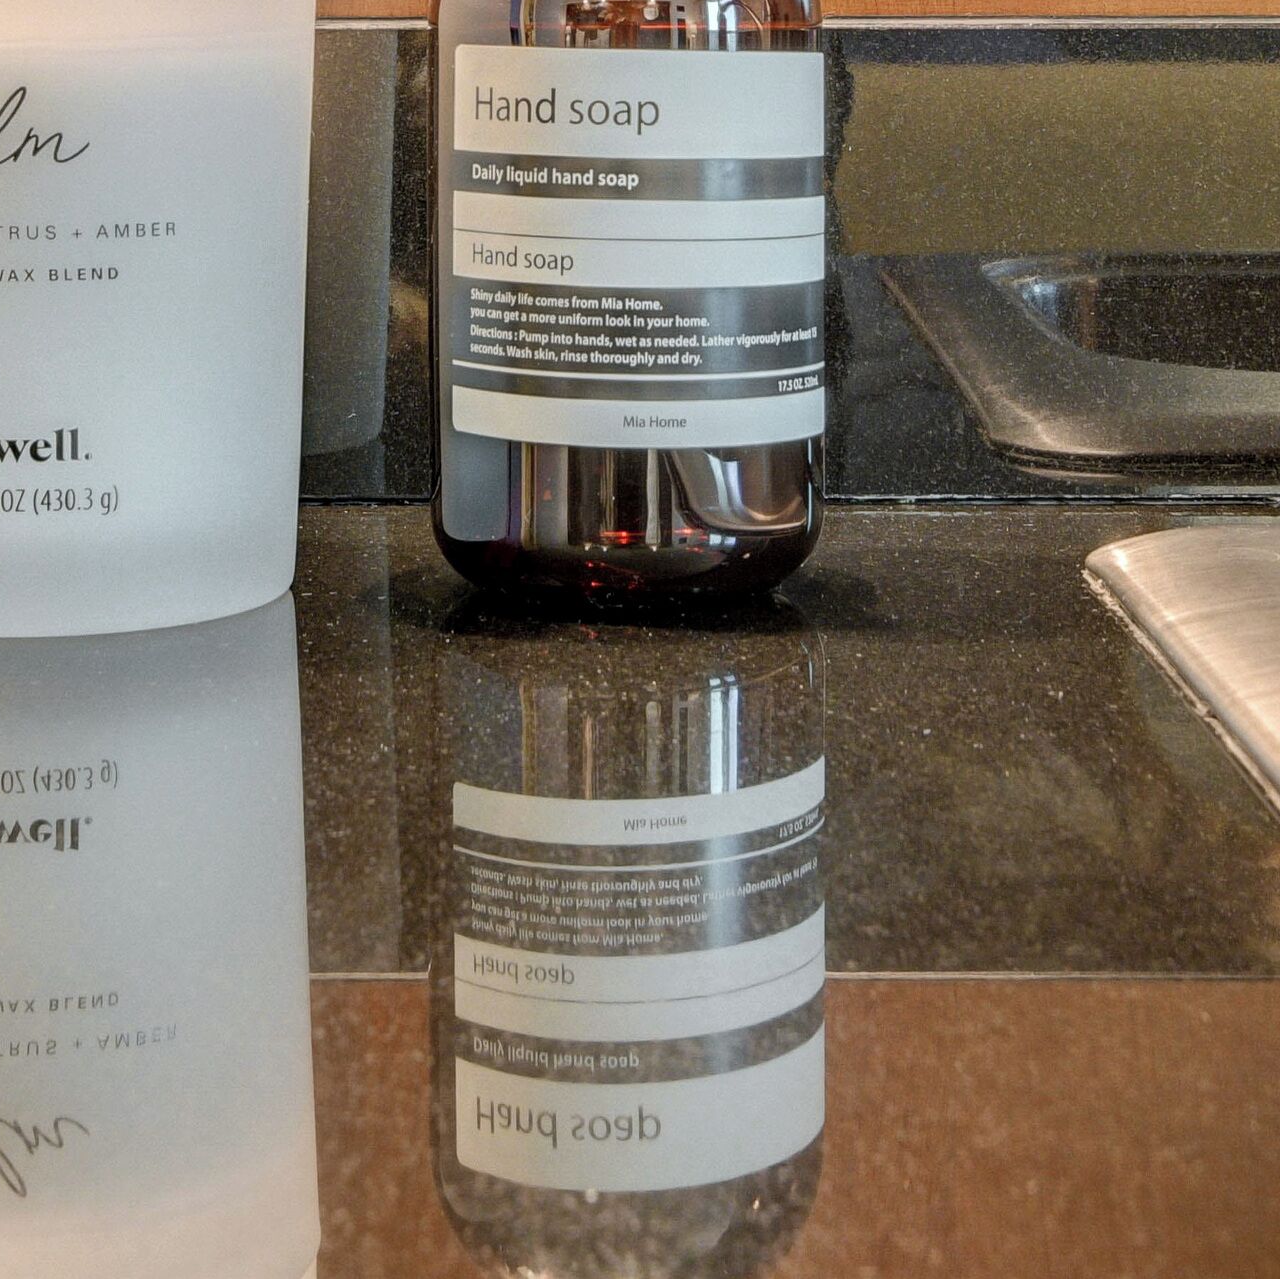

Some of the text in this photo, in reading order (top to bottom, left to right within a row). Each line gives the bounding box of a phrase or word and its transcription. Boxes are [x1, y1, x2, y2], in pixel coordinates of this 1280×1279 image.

[475, 86, 660, 135] Hand soap
[472, 163, 639, 190] Daily liquid hand soap
[96, 222, 177, 239] AMBER
[472, 243, 574, 276] Hand soap
[48, 267, 119, 281] BLEND
[470, 288, 663, 311] Shiny daily life comes from Mia Home.
[470, 308, 710, 330] you can get a more uniform look in your home.
[470, 324, 513, 340] Directions
[519, 329, 549, 346] Pump
[550, 332, 573, 345] into
[575, 333, 613, 348] hands,
[615, 336, 637, 347] wet
[639, 337, 652, 347] as
[654, 334, 700, 347] needed.
[702, 333, 734, 347] Lather
[736, 331, 781, 348] vigorously
[781, 329, 792, 342] for
[792, 330, 799, 341] at
[799, 328, 811, 340] least
[470, 343, 702, 367] seconds. Wash skin, rinse thoroughly and dry.
[623, 415, 687, 428] Mia Home
[0, 489, 26, 512] OZ
[33, 487, 93, 515] (430.3
[101, 485, 118, 515] g)
